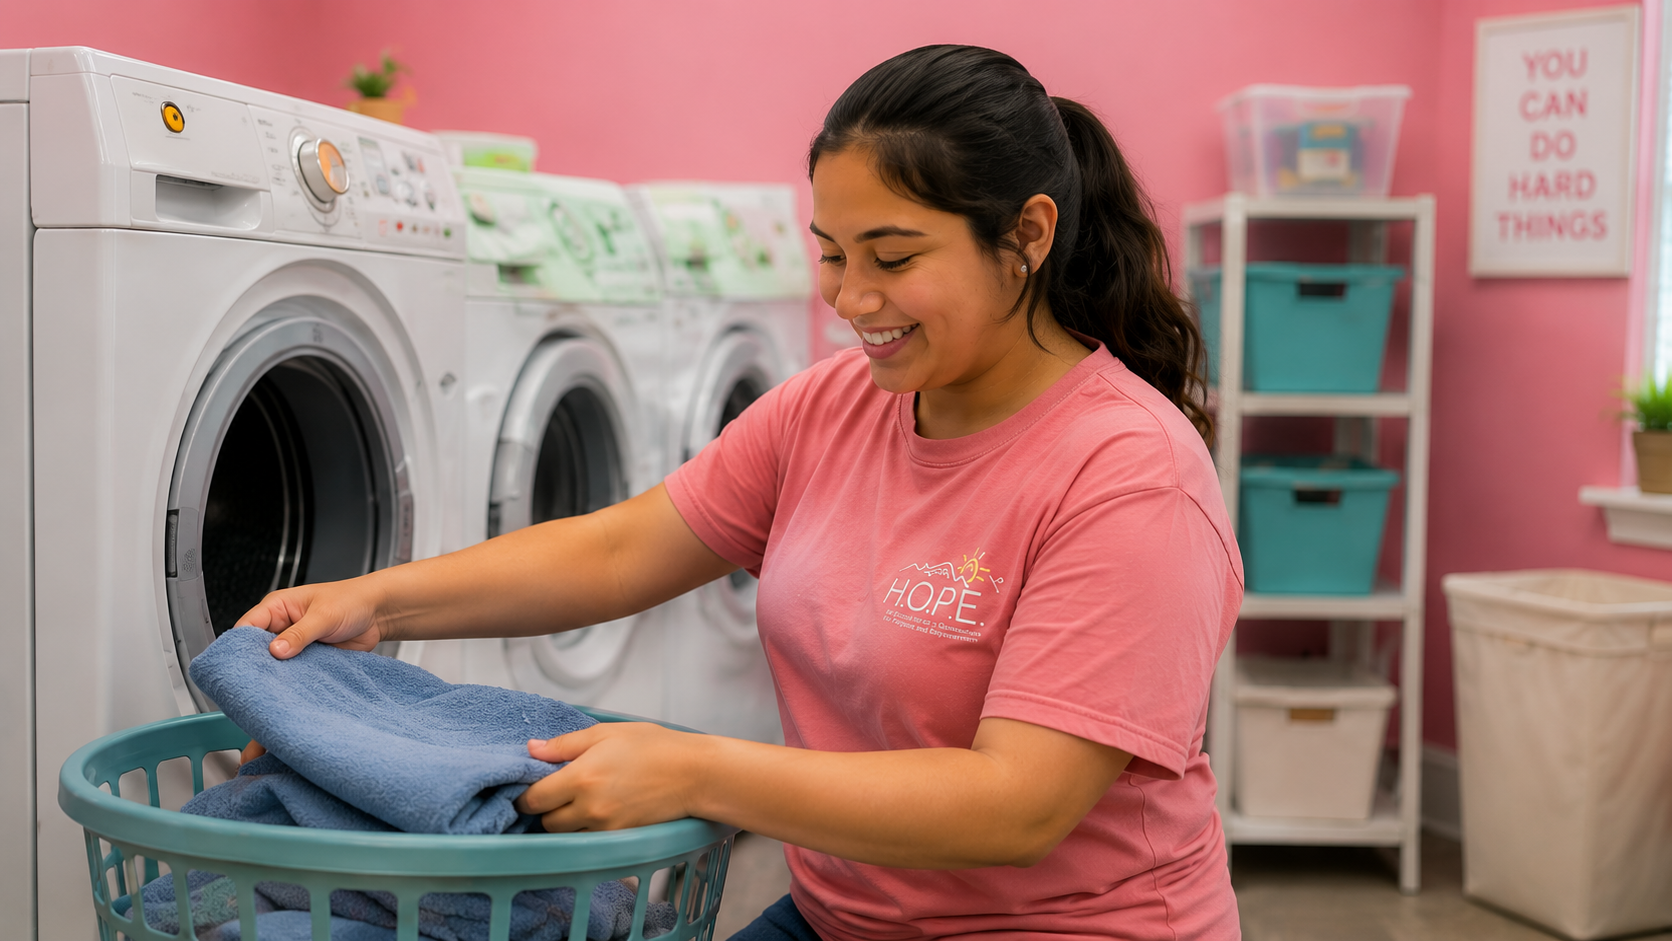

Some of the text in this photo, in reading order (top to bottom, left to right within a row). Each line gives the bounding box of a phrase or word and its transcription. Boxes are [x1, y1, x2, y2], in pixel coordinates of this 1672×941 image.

[1521, 48, 1588, 81] YOU
[1519, 89, 1588, 121] CAN
[1530, 129, 1577, 161] DO
[1508, 169, 1597, 202] HARD
[1497, 209, 1608, 242] THINGS
[883, 577, 985, 627] H.O.P.E.
